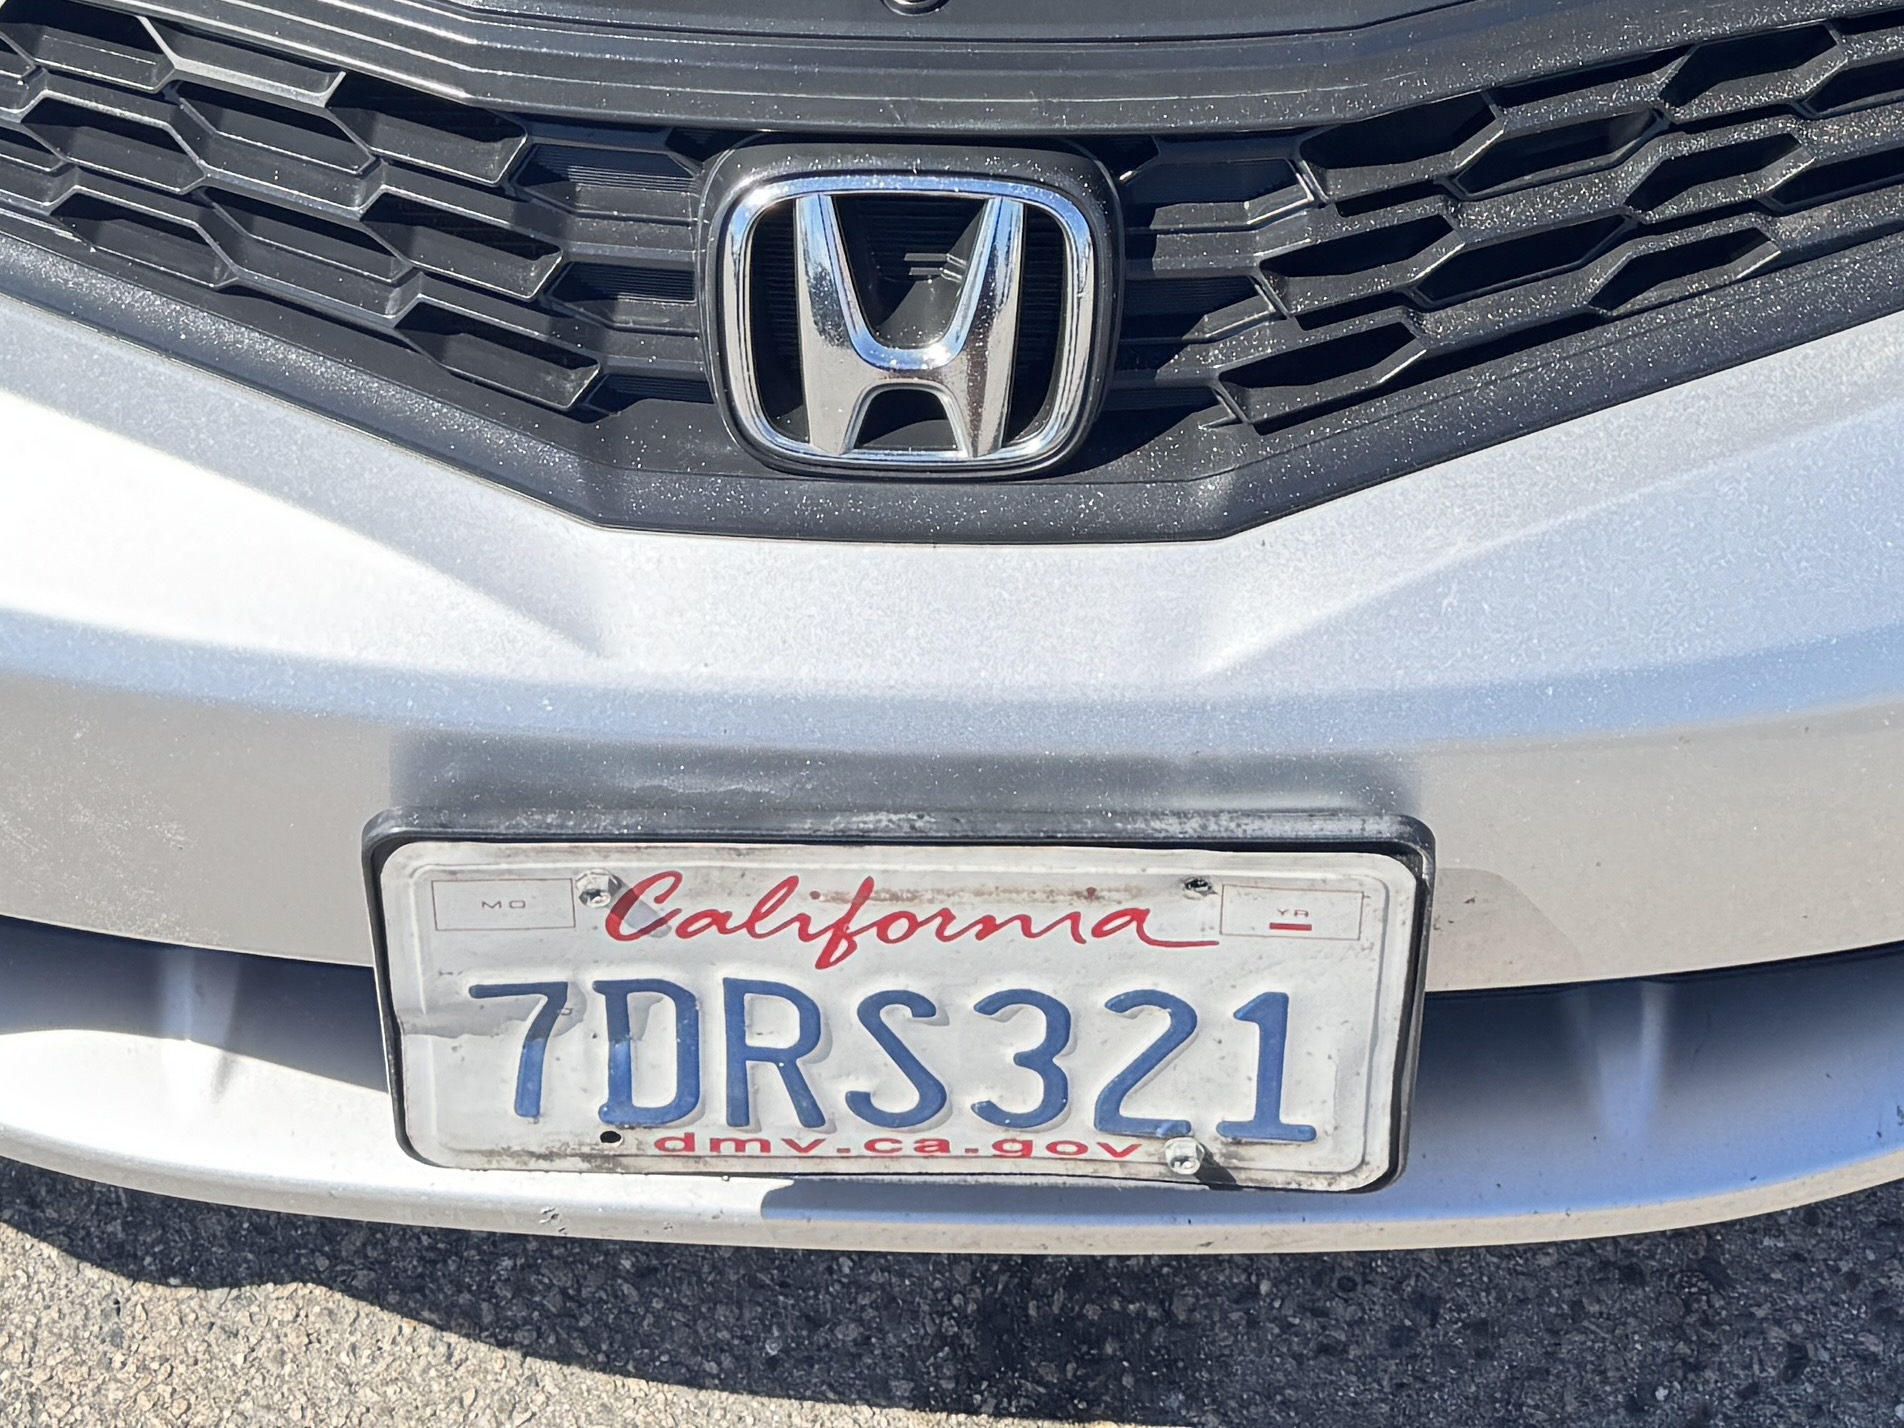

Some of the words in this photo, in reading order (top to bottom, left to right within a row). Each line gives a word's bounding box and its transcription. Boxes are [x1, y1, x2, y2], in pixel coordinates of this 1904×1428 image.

[480, 899, 527, 910] MO
[604, 870, 1220, 970] California
[1276, 908, 1310, 919] YR
[468, 977, 1317, 1142] 7DRS321
[653, 1132, 1144, 1159] dmv.ca.gov
